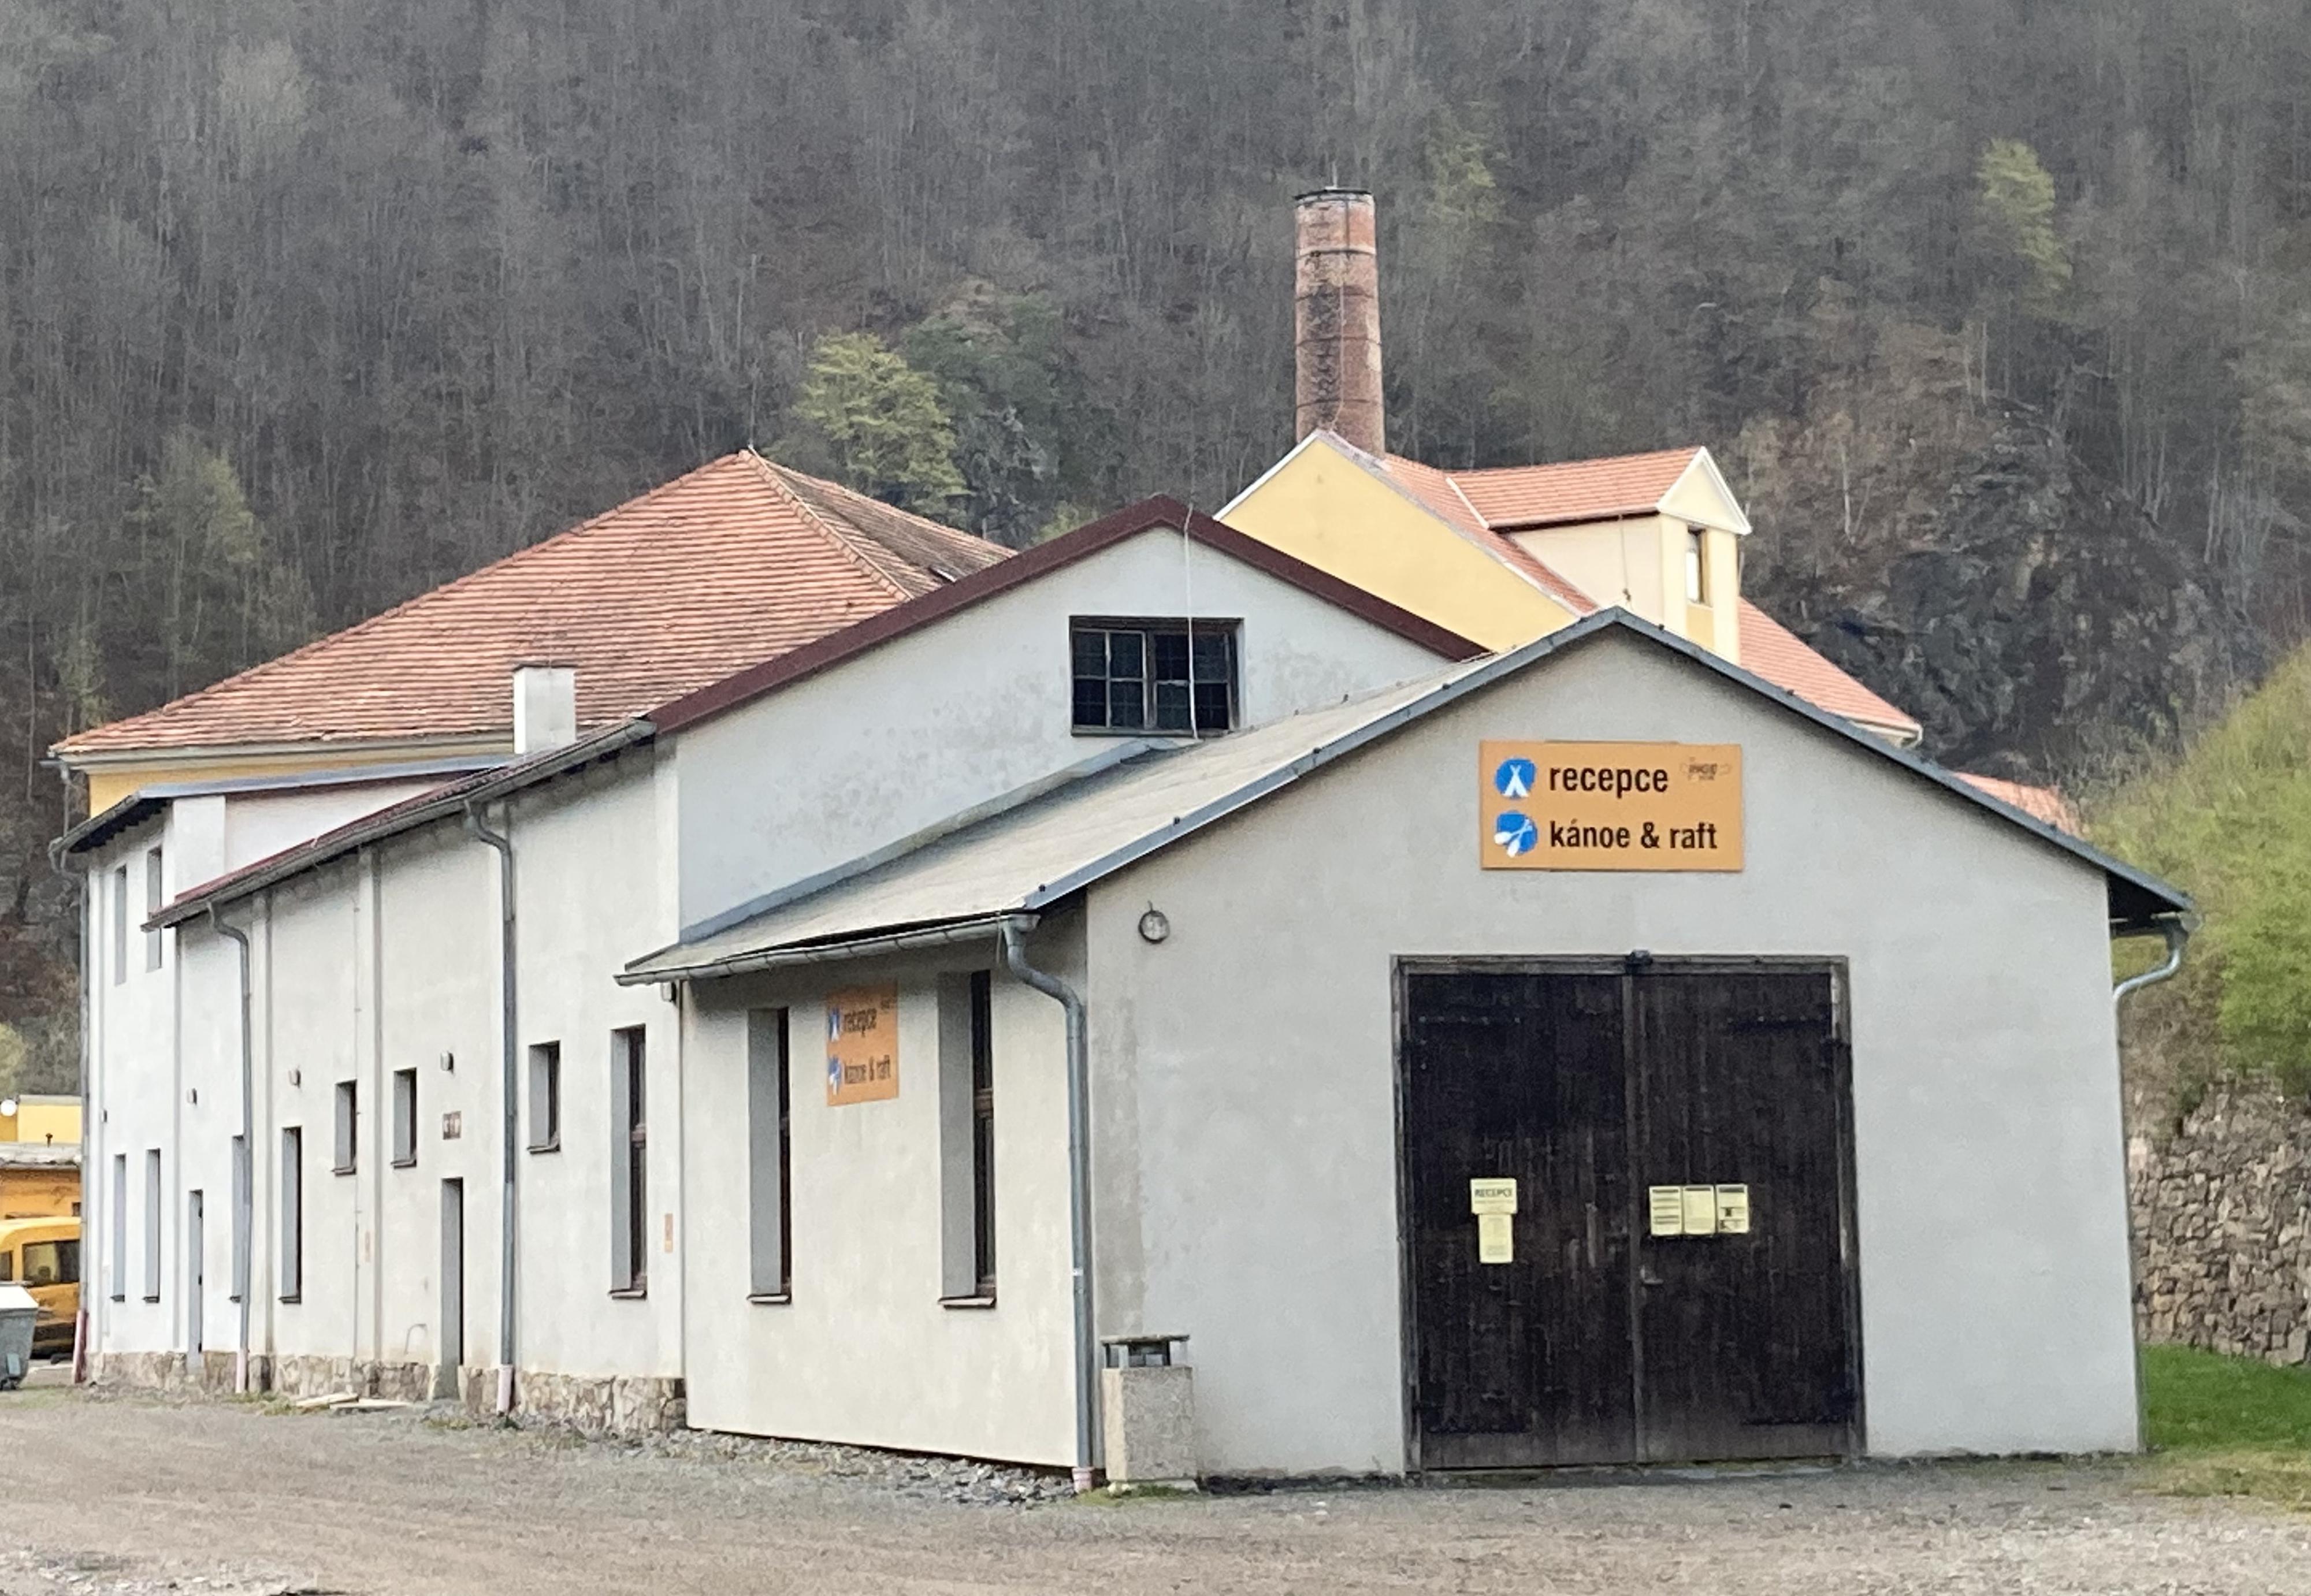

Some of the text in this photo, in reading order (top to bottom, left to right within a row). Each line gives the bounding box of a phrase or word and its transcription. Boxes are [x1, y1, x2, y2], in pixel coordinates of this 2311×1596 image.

[1550, 767, 1669, 799] recepce
[1550, 818, 1718, 849] kánoe & raft
